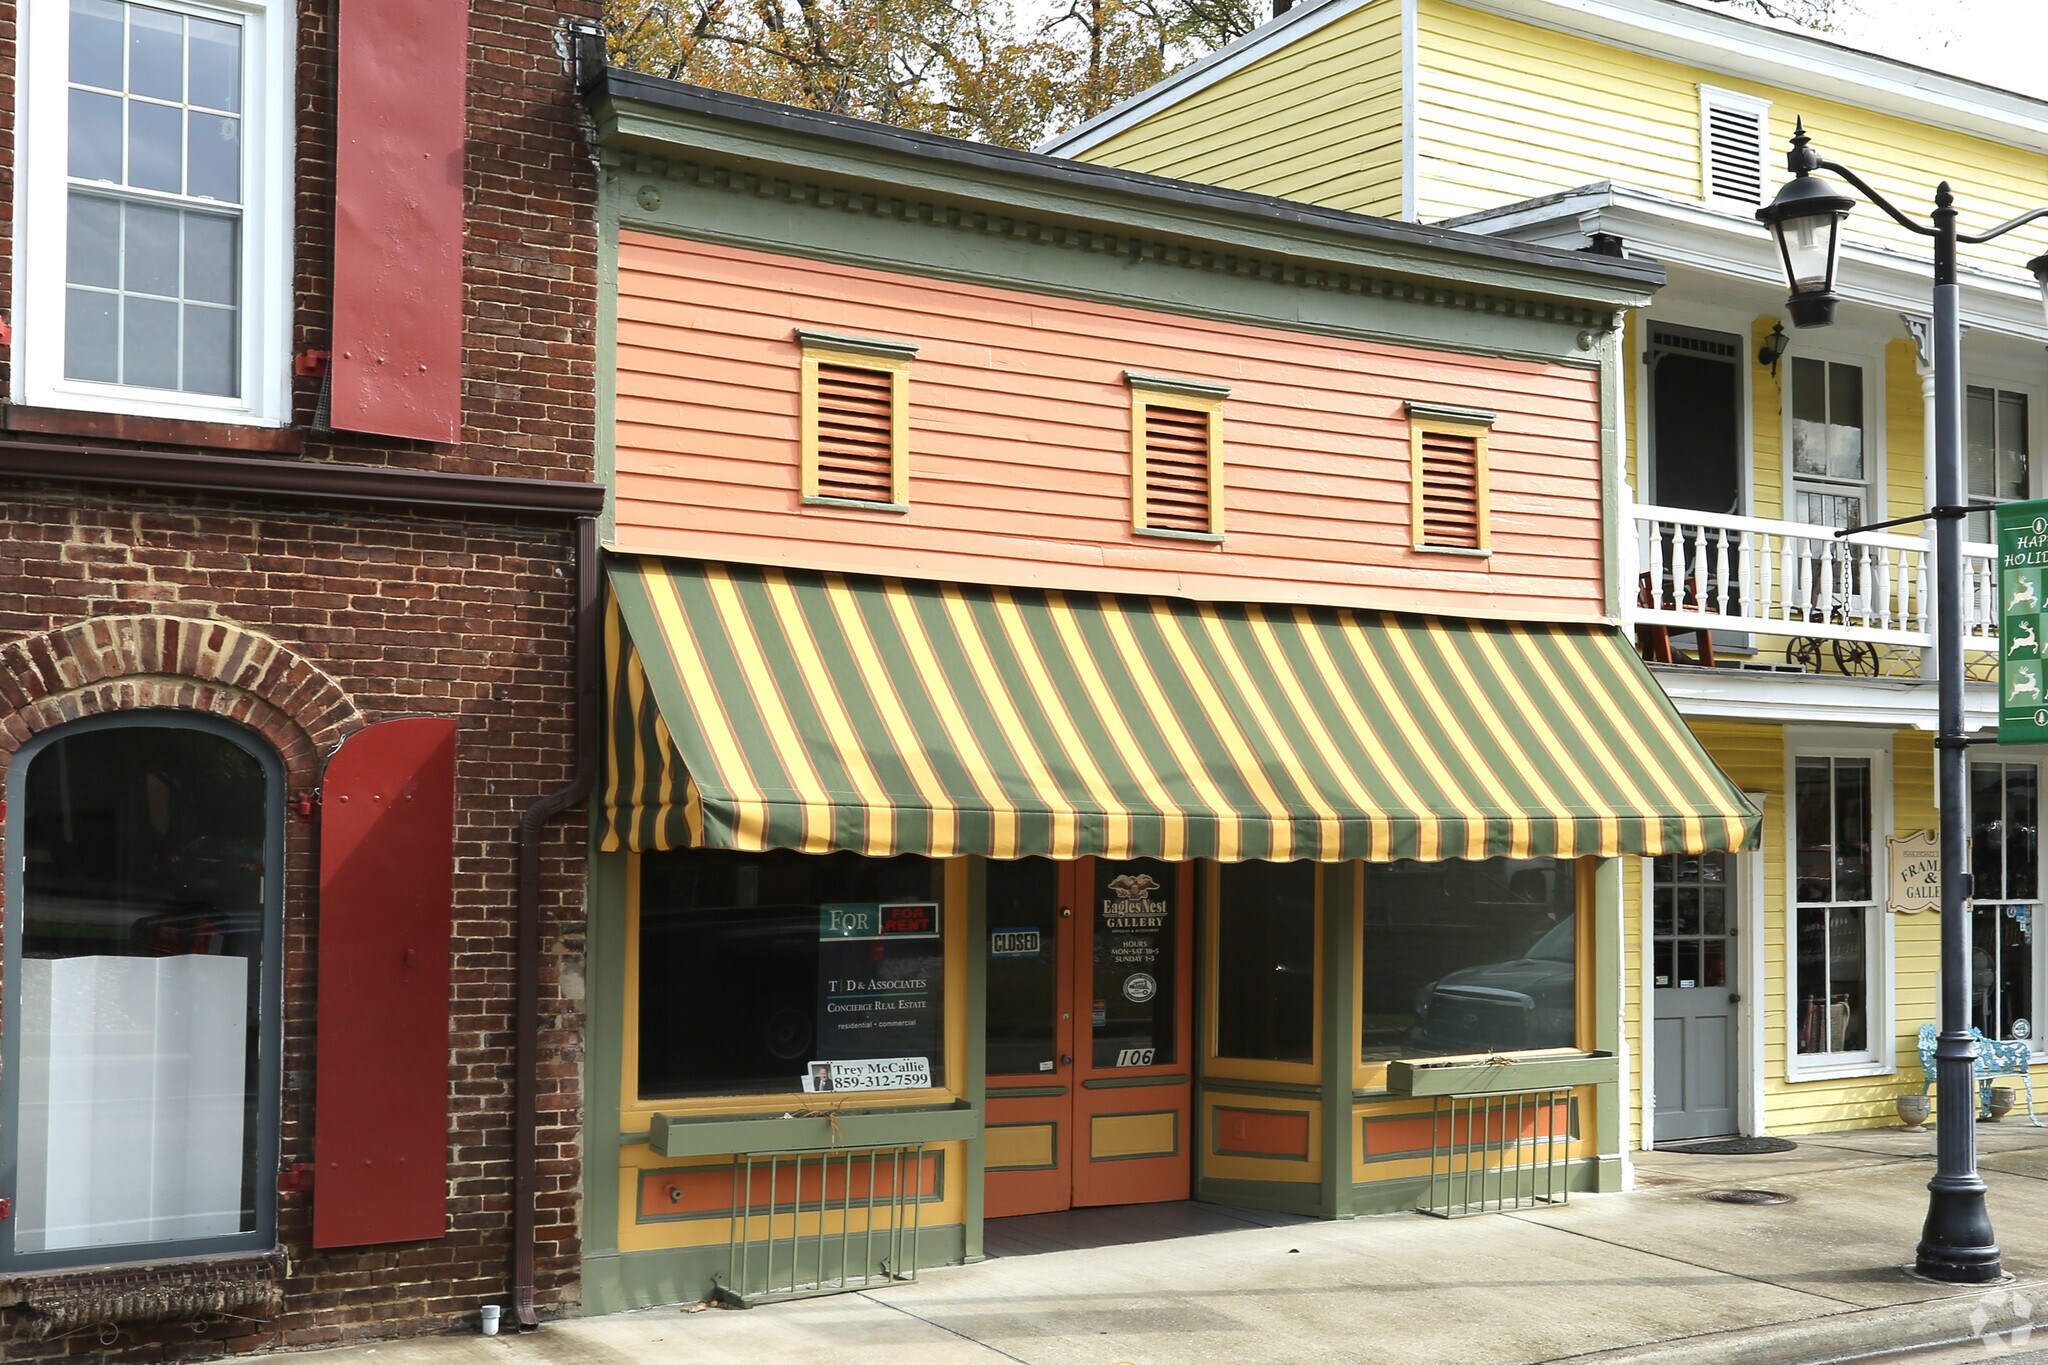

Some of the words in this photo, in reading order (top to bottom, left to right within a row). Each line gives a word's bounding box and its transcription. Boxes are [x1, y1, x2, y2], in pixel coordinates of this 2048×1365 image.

[2017, 534, 2048, 550] HAP
[1900, 859, 1941, 883] FRAM
[1924, 872, 1937, 884] &
[892, 908, 924, 919] FOR
[1103, 899, 1142, 918] Eagles
[1141, 899, 1167, 913] Nest
[828, 908, 870, 931] FOR
[885, 919, 929, 931] RENT
[1106, 917, 1163, 928] GALLERY
[994, 933, 1038, 952] CLOSED
[1122, 940, 1148, 948] HOURS
[1115, 955, 1142, 963] SUNDAY
[828, 980, 838, 992] T
[846, 979, 856, 991] D
[857, 981, 865, 990] &
[867, 979, 927, 990] ASSOCIATES
[827, 1002, 873, 1013] CONCIERGE
[874, 1000, 896, 1010] REAL
[899, 999, 928, 1009] ESTATE
[838, 1021, 873, 1030] residential
[878, 1019, 917, 1028] commercial
[1121, 1049, 1153, 1066] 106
[833, 1064, 864, 1077] Trey
[868, 1061, 925, 1074] McCallie
[834, 1074, 929, 1089] 859-312-7599
